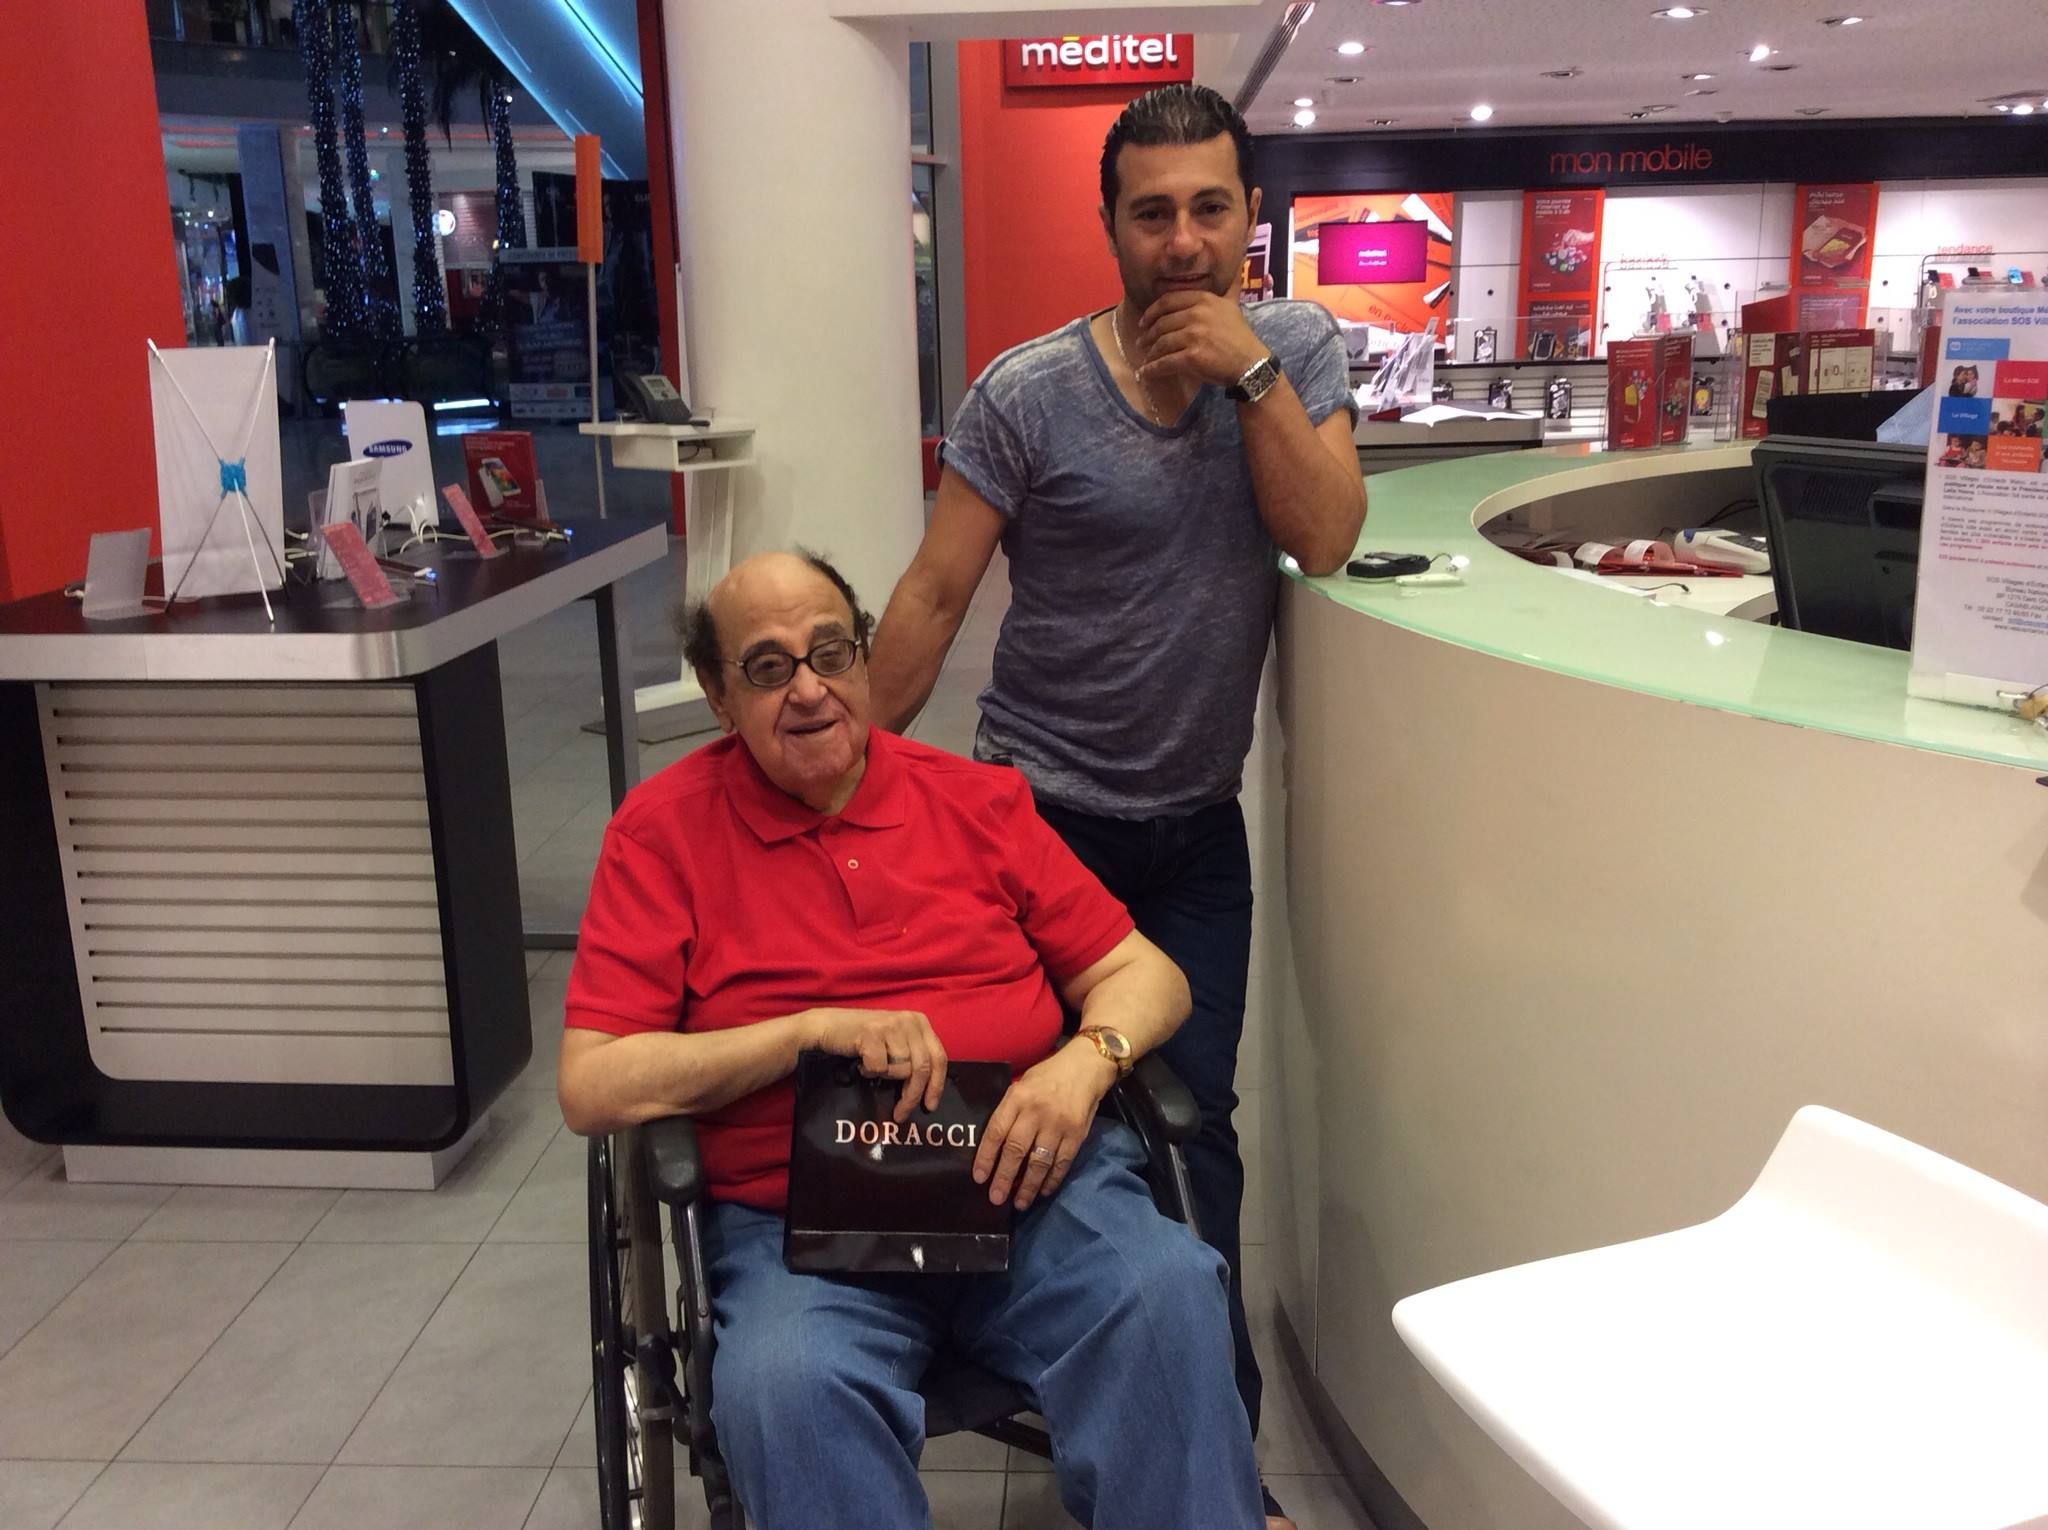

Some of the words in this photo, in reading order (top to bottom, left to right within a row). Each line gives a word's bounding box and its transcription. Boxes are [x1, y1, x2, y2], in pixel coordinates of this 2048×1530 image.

[1550, 151, 1612, 174] mon
[1619, 143, 1713, 173] mobile
[1998, 305, 2035, 316] boutique
[1952, 316, 2009, 326] l'association
[2010, 316, 2031, 326] SOS
[369, 444, 408, 454] SAMSUNG
[834, 1119, 977, 1148] DORACCI
